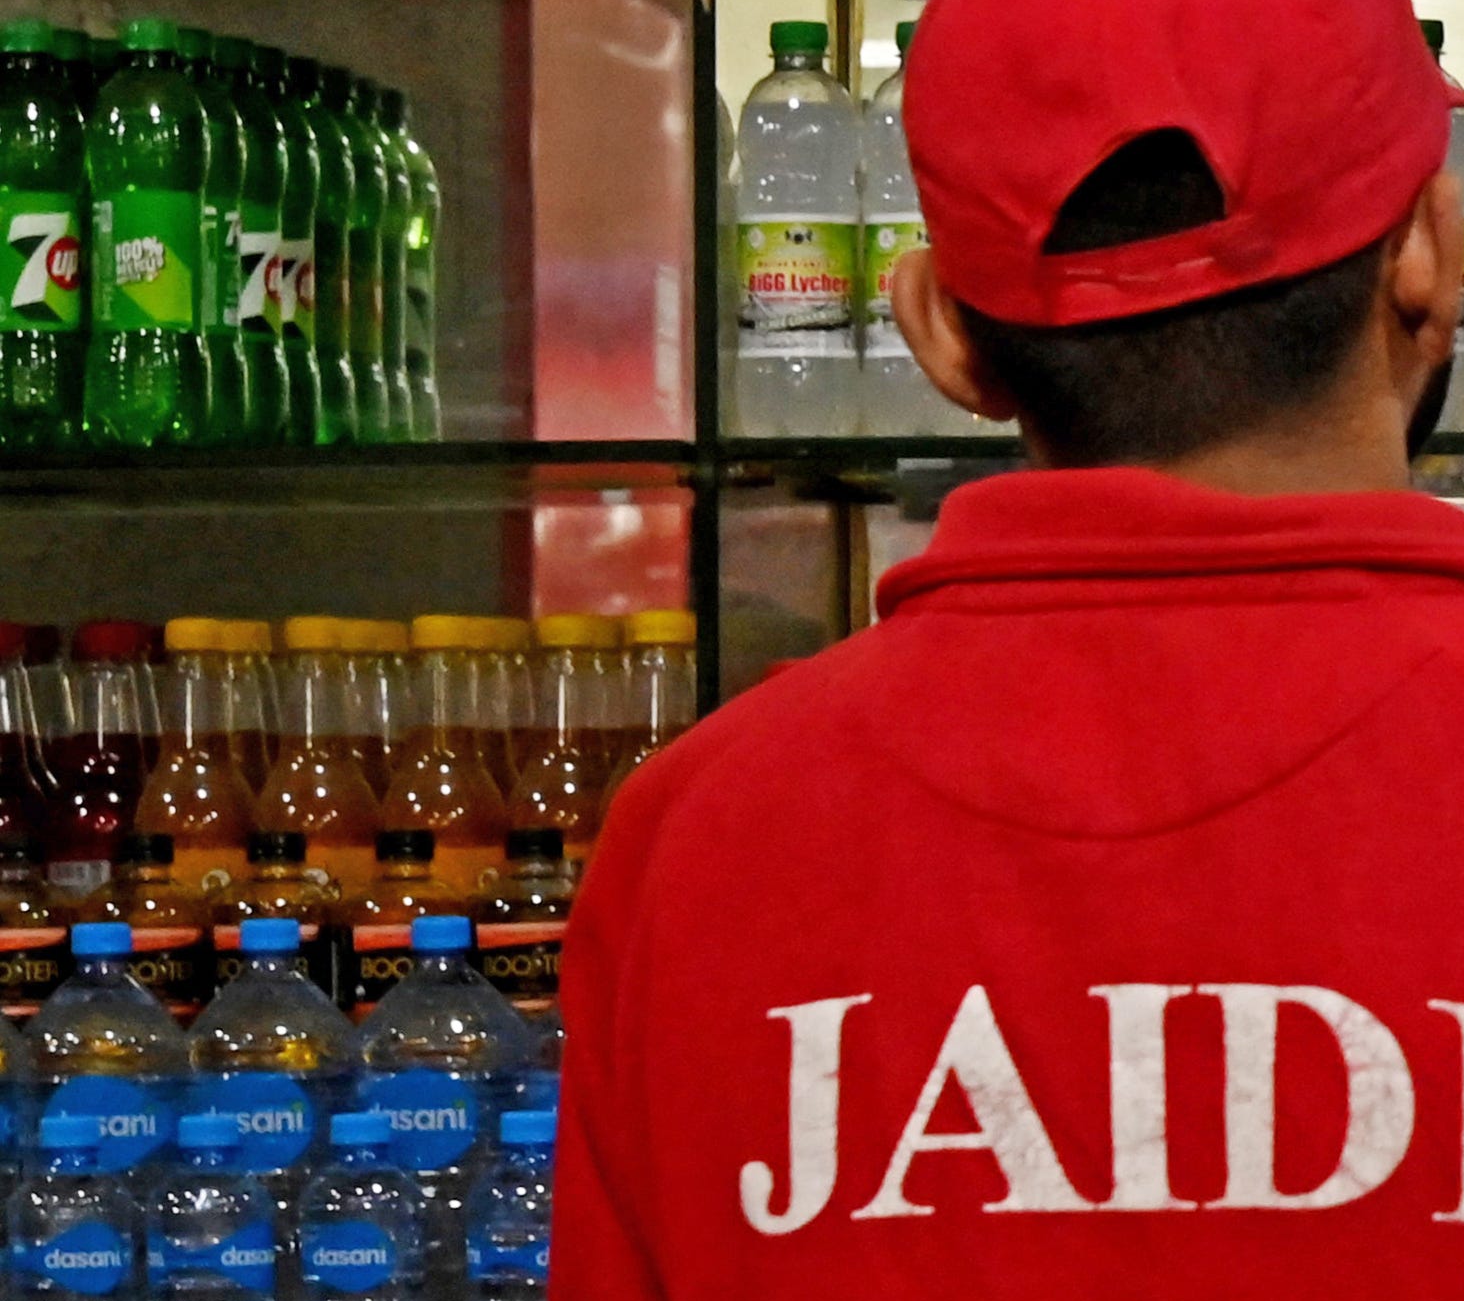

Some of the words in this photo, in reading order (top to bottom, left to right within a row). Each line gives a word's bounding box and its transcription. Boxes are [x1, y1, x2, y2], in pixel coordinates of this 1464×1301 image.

[7, 213, 71, 313] 7
[44, 1245, 121, 1269] dasani
[313, 1244, 388, 1268] dasani
